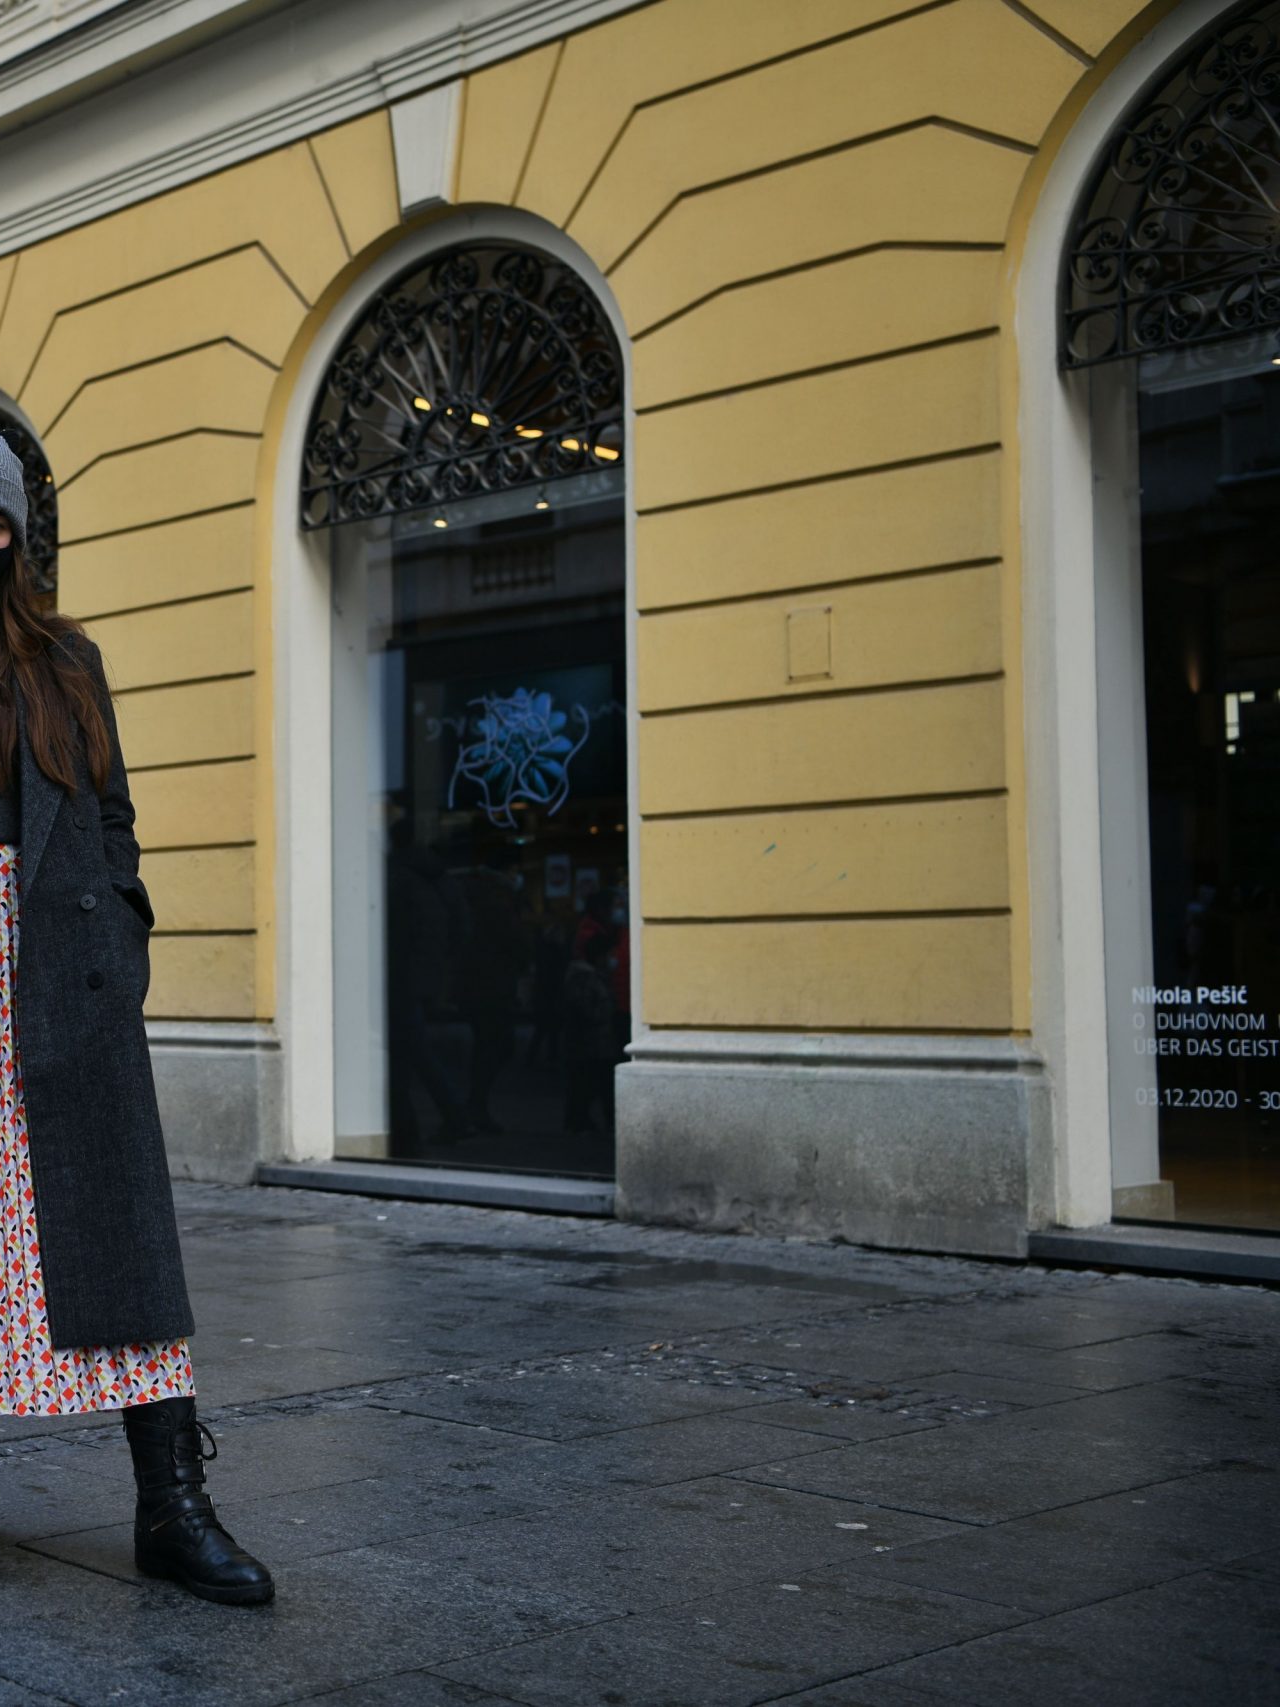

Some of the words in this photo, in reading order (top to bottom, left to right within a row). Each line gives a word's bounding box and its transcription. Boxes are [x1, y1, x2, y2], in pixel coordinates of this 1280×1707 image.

[1132, 985, 1192, 1004] Nikola
[1196, 985, 1248, 1004] Pešić
[1133, 1012, 1146, 1030] O
[1156, 1012, 1265, 1031] DUHOVNOM
[1186, 1038, 1222, 1056] DAS
[1135, 1087, 1238, 1108] 03.12.2020
